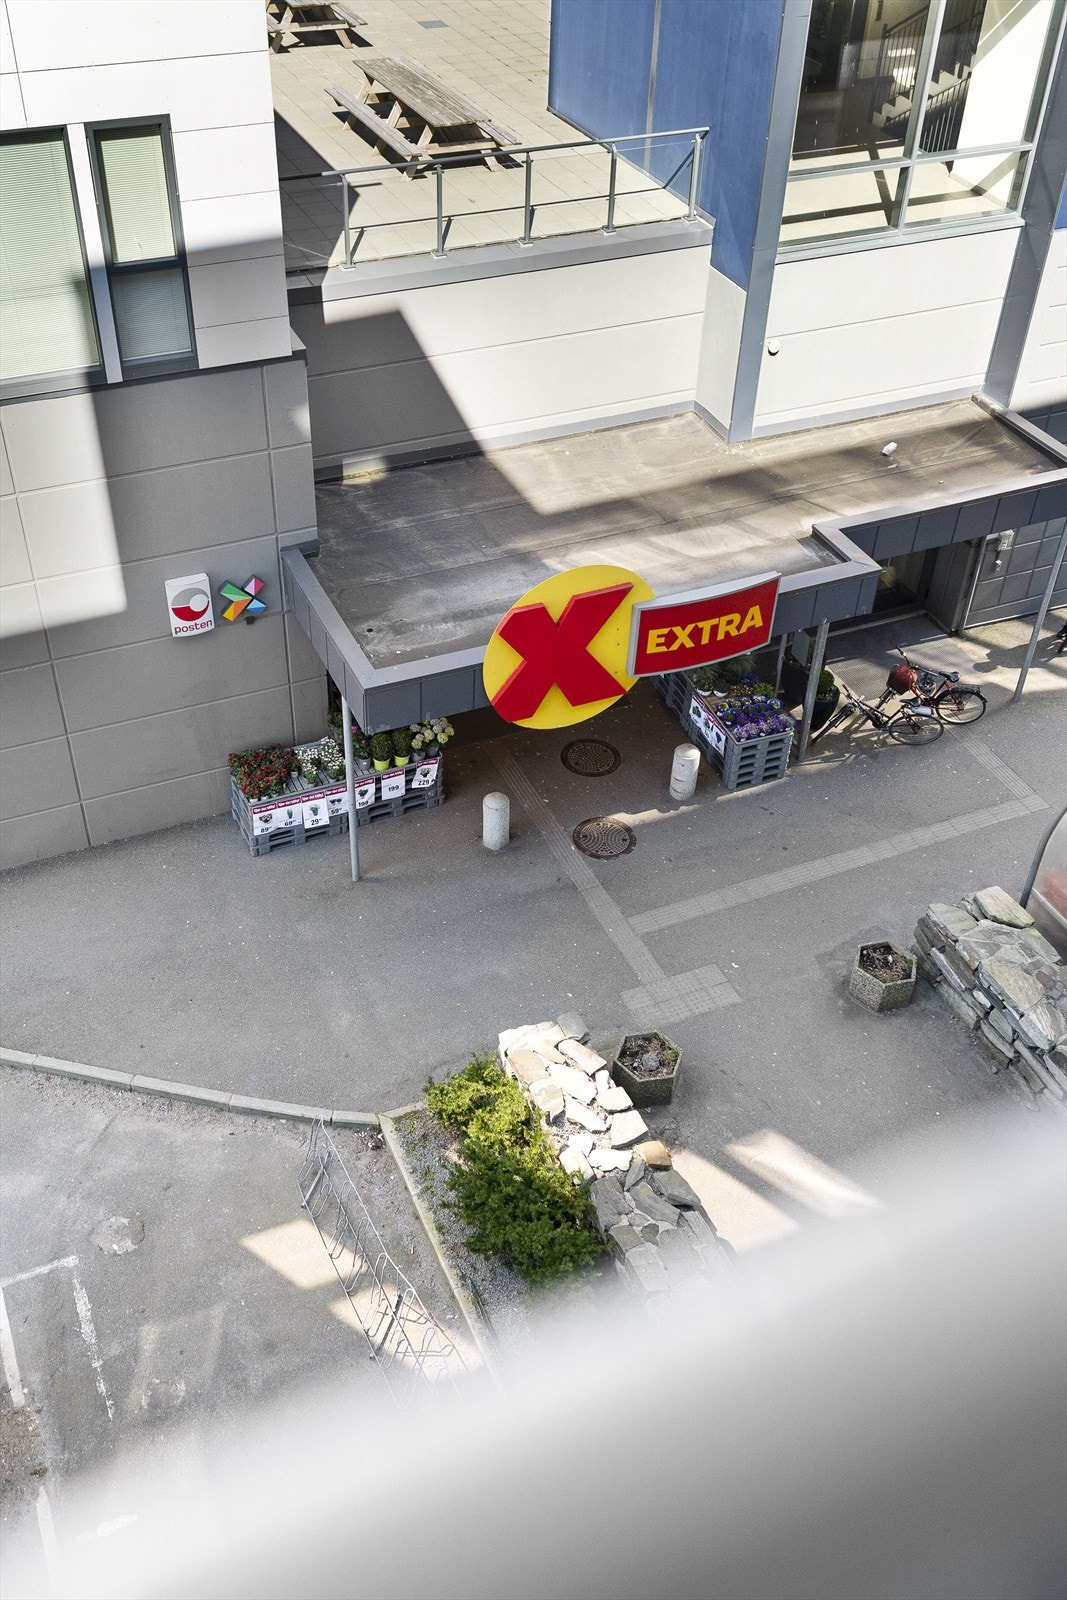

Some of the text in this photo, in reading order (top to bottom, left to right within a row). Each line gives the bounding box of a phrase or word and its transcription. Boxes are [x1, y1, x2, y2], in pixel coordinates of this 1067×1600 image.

[174, 618, 213, 635] posten
[646, 604, 764, 655] EXTRA
[490, 582, 634, 723] X
